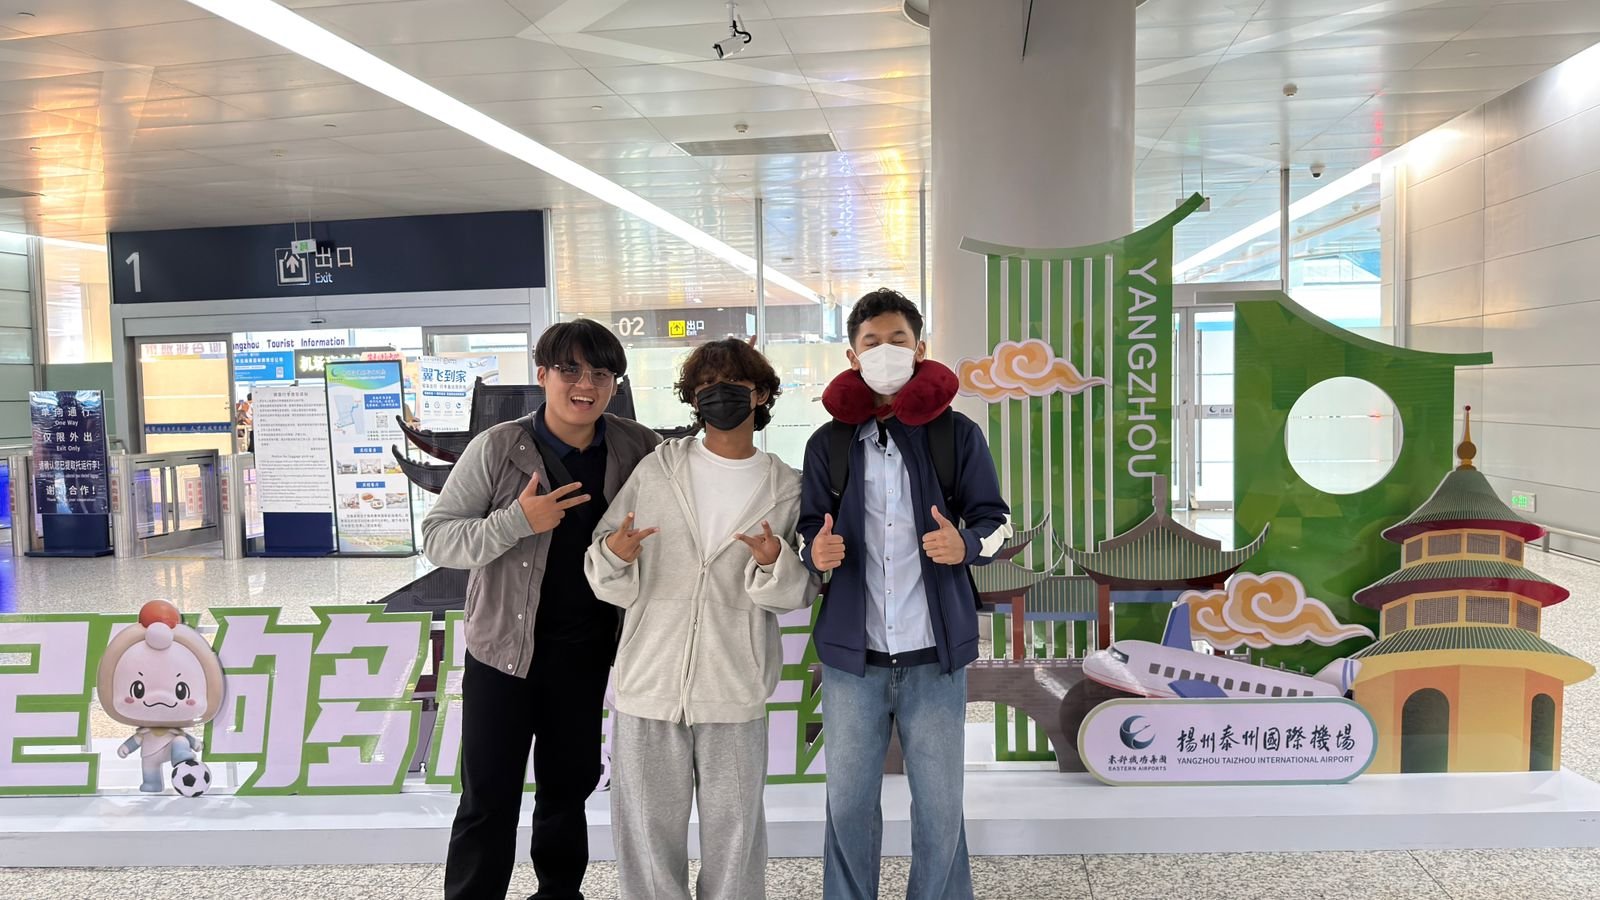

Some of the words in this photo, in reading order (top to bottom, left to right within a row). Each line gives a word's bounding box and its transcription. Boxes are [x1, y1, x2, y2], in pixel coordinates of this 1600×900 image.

[315, 246, 353, 268] 出口
[125, 251, 142, 293] 1
[314, 271, 333, 283] Exit
[619, 317, 644, 336] 02
[686, 320, 704, 330] 出口
[267, 338, 294, 349] Tourist
[301, 337, 345, 347] Information
[1127, 258, 1158, 478] YANGZHOU
[43, 432, 92, 442] 仅限外出
[68, 445, 80, 453] Only
[1177, 757, 1220, 765] YANGZHOU
[1222, 756, 1256, 764] TAIZHOU
[1257, 755, 1319, 764] INTERNATIONAL
[1320, 755, 1354, 763] AIRPORT
